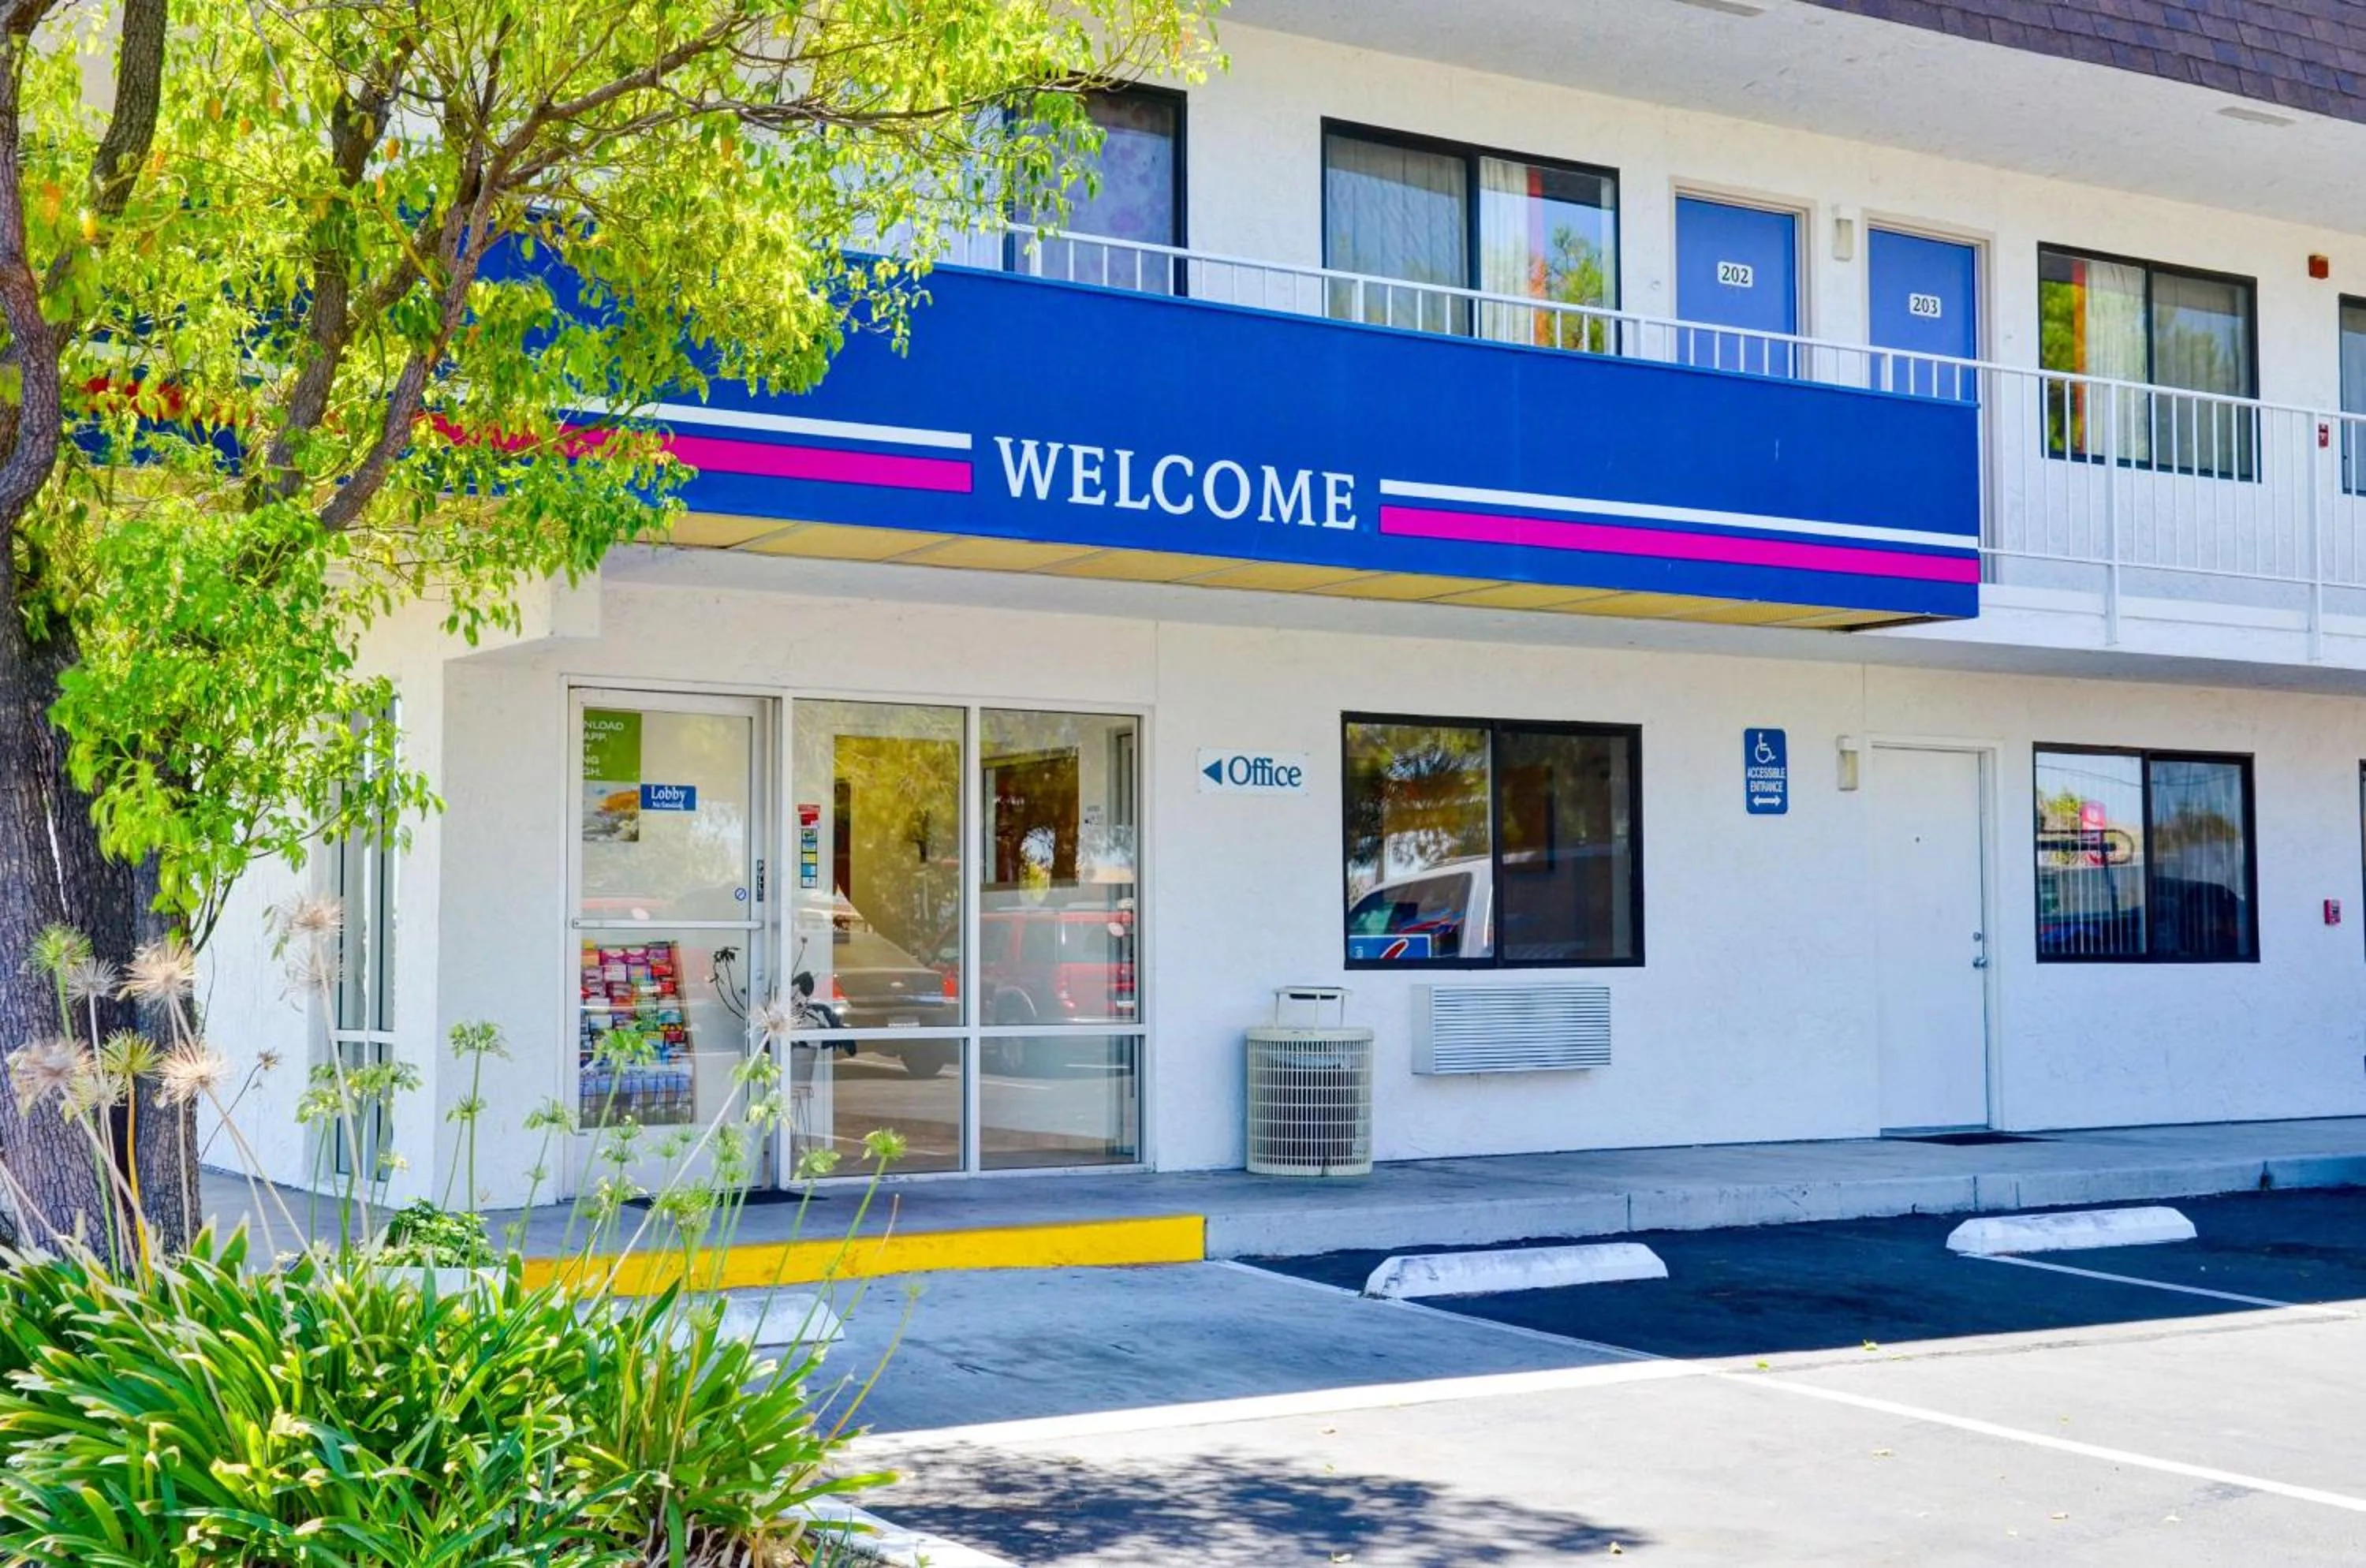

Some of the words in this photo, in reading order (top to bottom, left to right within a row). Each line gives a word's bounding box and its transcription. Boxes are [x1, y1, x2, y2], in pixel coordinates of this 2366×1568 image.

[1721, 265, 1749, 284] 202
[1913, 297, 1938, 315] 203
[994, 435, 1357, 531] WELCOME
[1228, 755, 1302, 787] Office
[1747, 767, 1786, 778] ACCESSIBLE
[651, 786, 688, 803] Lobby
[1750, 780, 1783, 793] ENTRANCE
